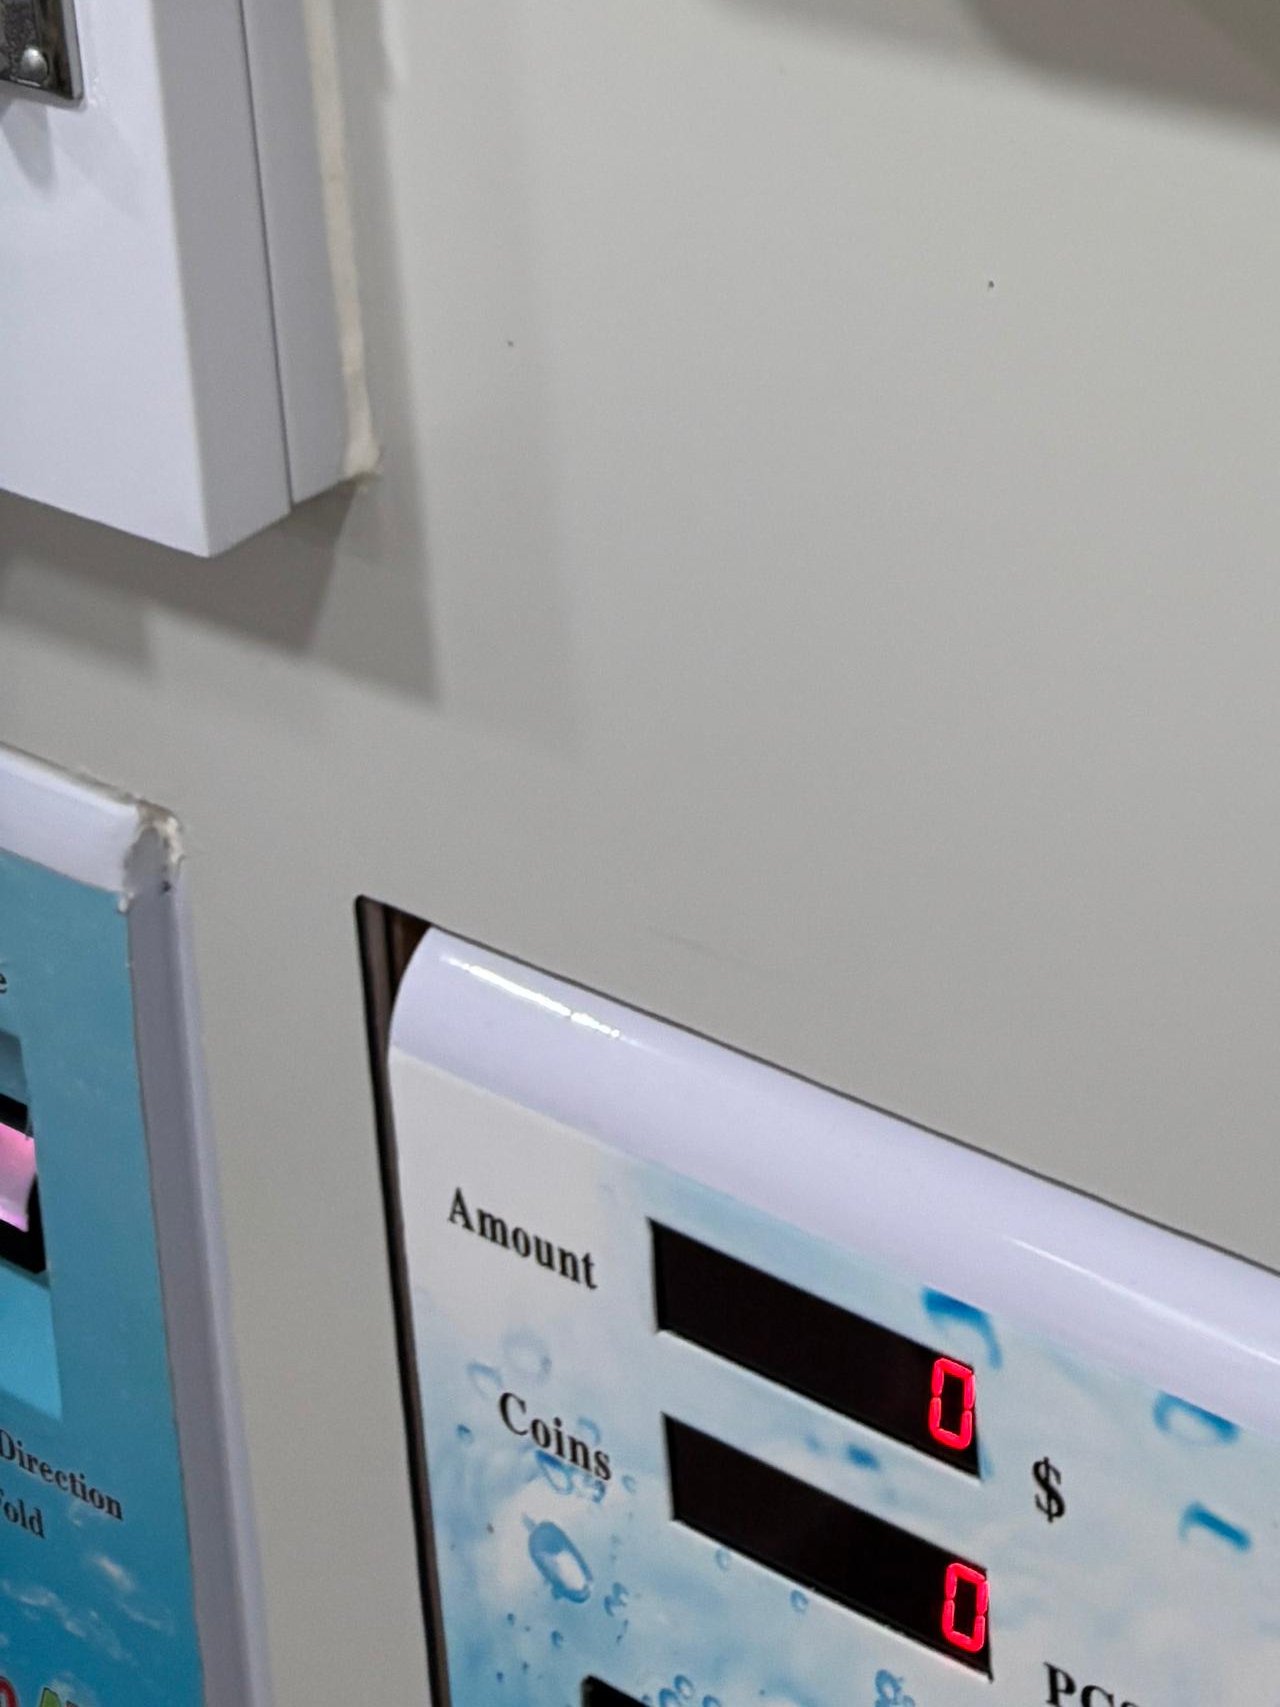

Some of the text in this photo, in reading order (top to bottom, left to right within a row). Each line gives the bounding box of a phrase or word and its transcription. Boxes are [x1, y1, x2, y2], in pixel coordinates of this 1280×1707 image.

[447, 1187, 600, 1292] Amount
[498, 1390, 613, 1483] Coins
[928, 1358, 976, 1452] 0
[0, 1488, 45, 1539] old
[1032, 1456, 1067, 1522] $
[943, 1562, 988, 1655] 0
